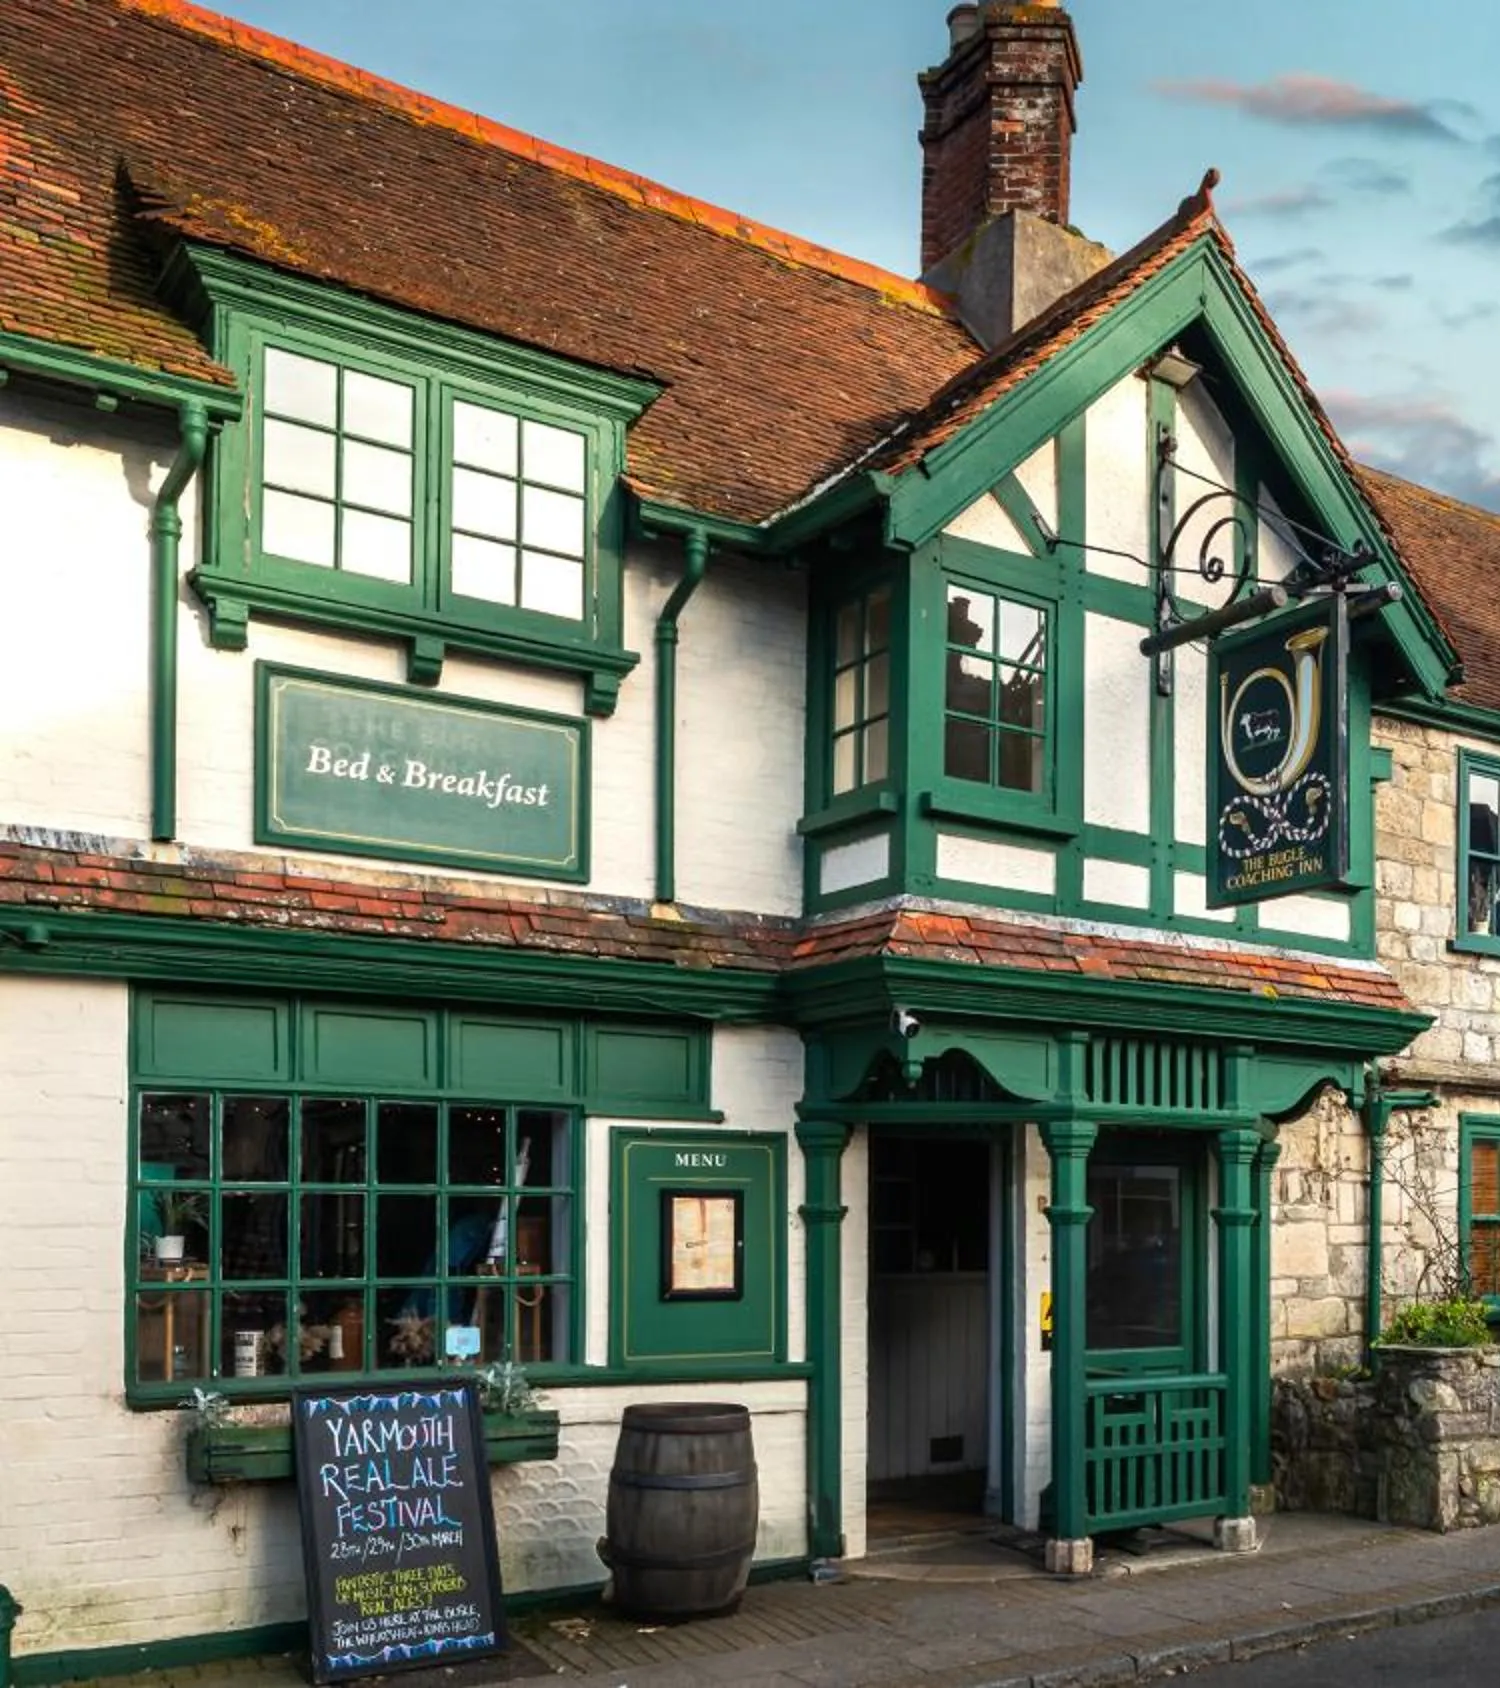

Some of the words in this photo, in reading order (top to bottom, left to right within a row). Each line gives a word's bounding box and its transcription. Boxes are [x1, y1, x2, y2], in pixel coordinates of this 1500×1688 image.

[306, 745, 370, 781] Bed
[376, 764, 396, 785] &
[402, 760, 549, 809] Breakfast
[1226, 863, 1293, 890] COACHING
[1299, 856, 1323, 874] INN
[1243, 855, 1264, 872] THE
[1269, 846, 1305, 869] BUGLE
[675, 1152, 727, 1168] MENU
[326, 1415, 454, 1458] YARMOUTH
[319, 1458, 410, 1500] REAL
[412, 1454, 464, 1489] ALE
[336, 1494, 463, 1538] FESTIVAL
